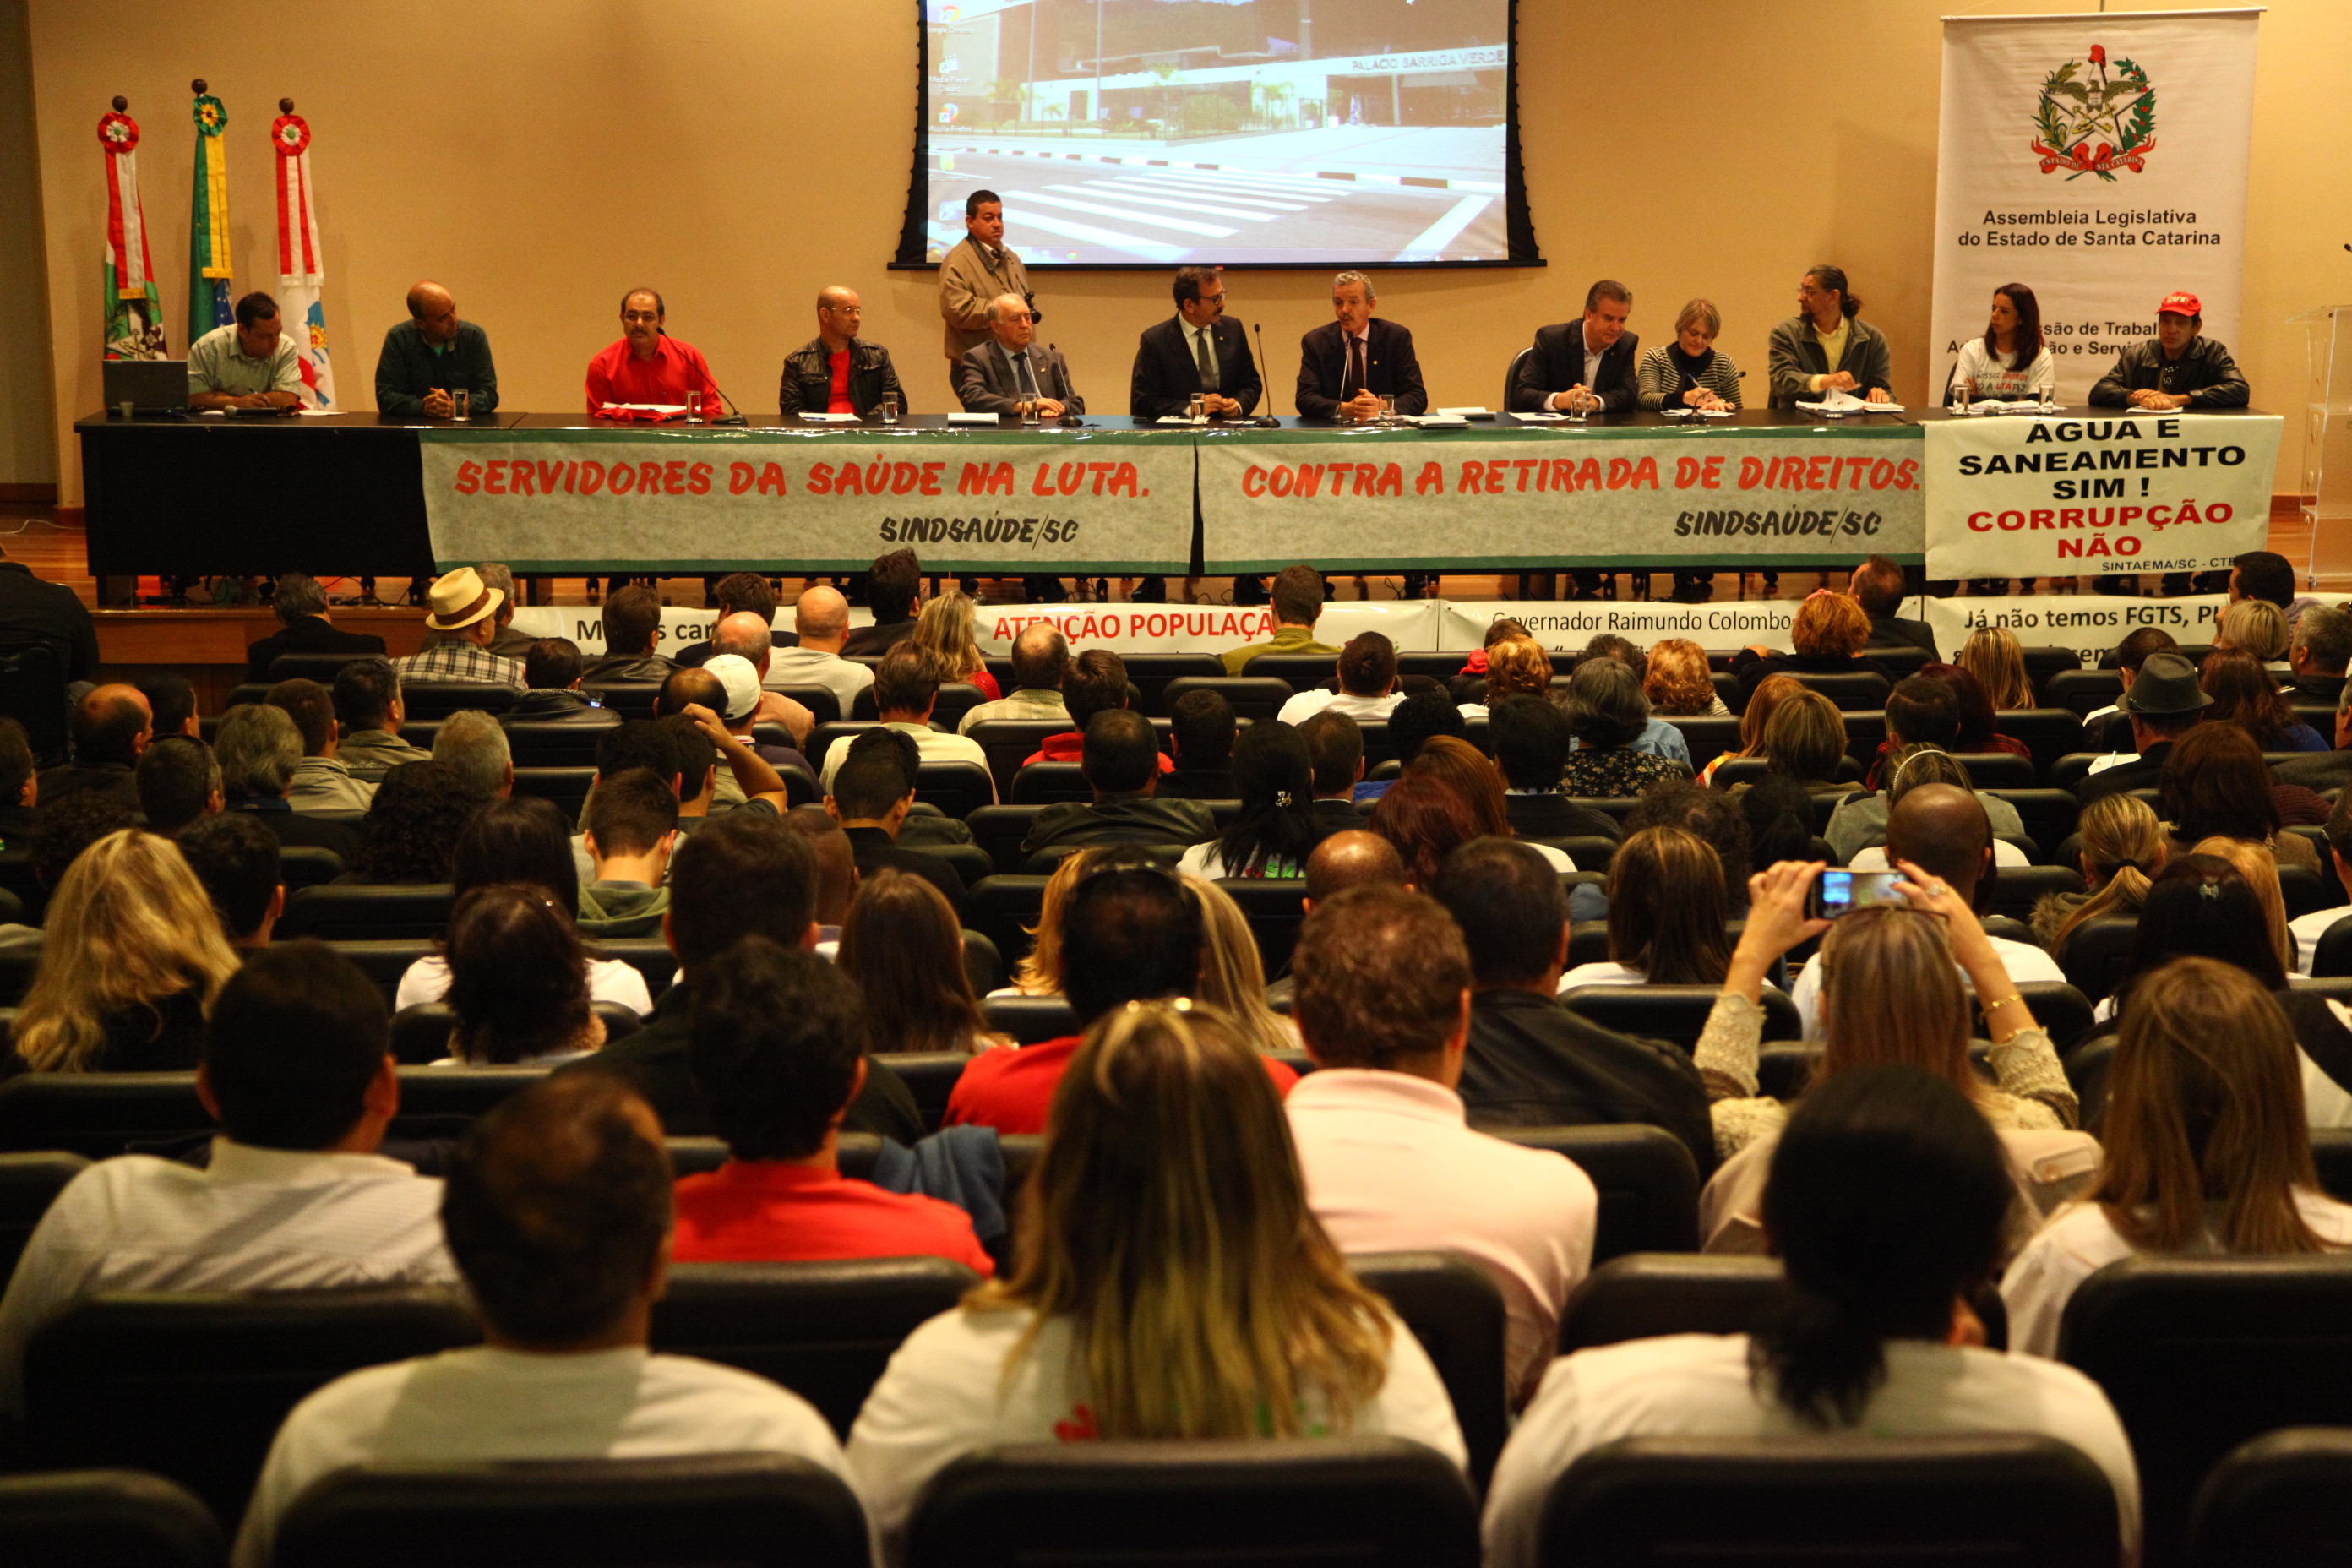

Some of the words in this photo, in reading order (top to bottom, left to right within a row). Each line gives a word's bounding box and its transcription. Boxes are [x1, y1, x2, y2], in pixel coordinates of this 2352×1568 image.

[1458, 49, 1505, 64] VERDE
[2112, 156, 2143, 168] CATARINA
[1983, 210, 2089, 225] Assembleia
[2095, 209, 2197, 228] Legislativa
[1958, 231, 1981, 246] do
[1986, 231, 2050, 246] Estado
[2055, 231, 2077, 246] de
[2083, 231, 2136, 246] Santa
[2142, 230, 2221, 245] Catarina
[2079, 322, 2099, 335] de
[2104, 322, 2157, 335] Trabal
[2073, 344, 2082, 354] e
[2157, 419, 2180, 438] E
[1958, 445, 2246, 476] SANEAMENTO
[454, 460, 714, 497] SERVIDORES
[728, 461, 787, 497] DA
[806, 453, 946, 496] SAÚDE
[956, 461, 1015, 496] NA
[1031, 461, 1150, 498] LUTA.
[1242, 462, 1402, 498] CONTRA
[1415, 461, 1444, 496] A
[1457, 456, 1659, 495] RETIRADA
[1674, 456, 1725, 490] DE
[1737, 455, 1920, 492] DIREITOS.
[2052, 477, 2125, 499] SIM
[1674, 504, 1882, 544] SINDSAÚDE/SC
[1967, 499, 2233, 531] CORRUPÇÃO
[879, 510, 1080, 551] SINDSAÚDE/SC
[2057, 533, 2142, 558] NÃO
[2102, 558, 2197, 572] SINTAEMA/SC
[1130, 607, 1276, 642] POPULAÇÃ
[1609, 611, 1702, 630] Raimundo
[1708, 610, 1791, 630] Colombo
[1964, 608, 1988, 629] Já
[1995, 608, 2039, 628] não
[2045, 609, 2119, 627] temos
[2126, 605, 2189, 629] FGTS,
[2198, 605, 2219, 623] PI
[675, 623, 712, 640] car
